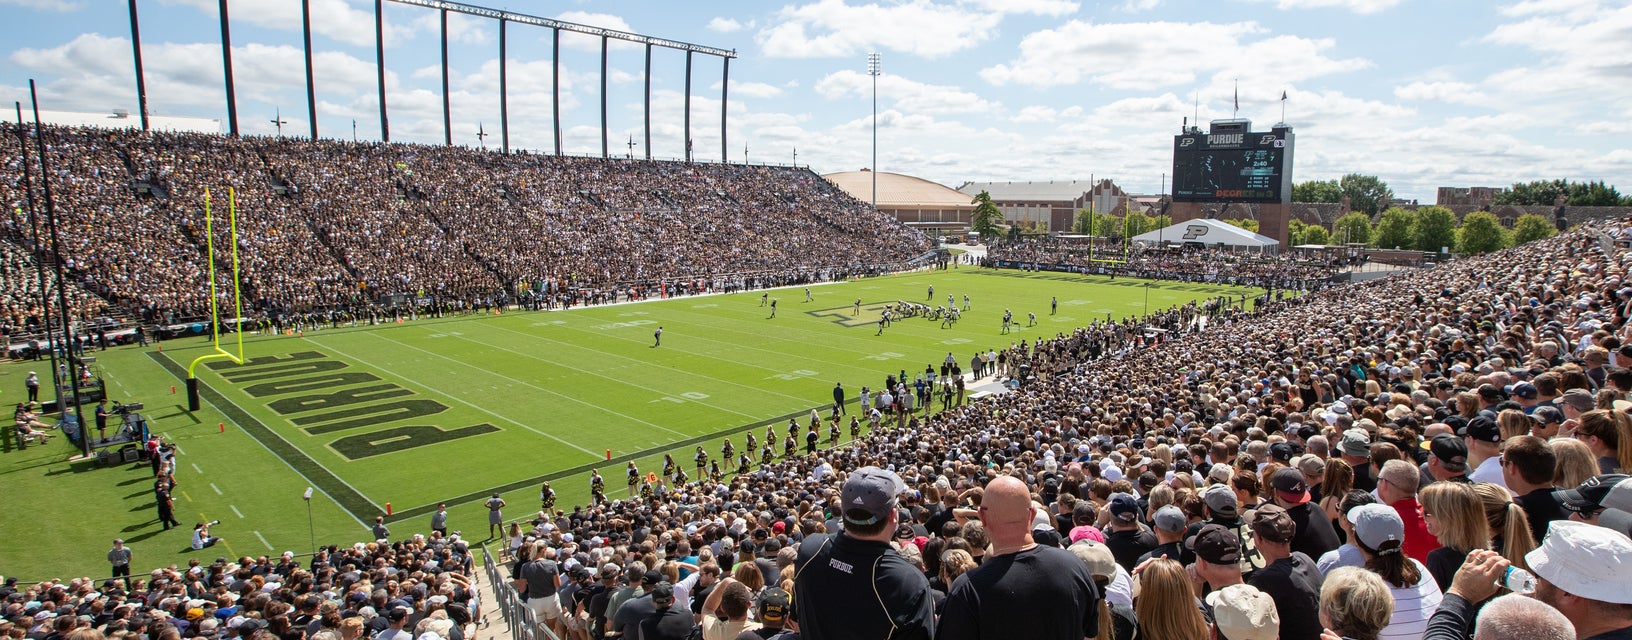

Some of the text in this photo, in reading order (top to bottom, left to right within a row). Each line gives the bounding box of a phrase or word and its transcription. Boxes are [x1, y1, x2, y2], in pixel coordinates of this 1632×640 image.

[1180, 138, 1194, 146] P
[1207, 134, 1243, 144] PURDUE
[1260, 135, 1276, 144] P
[1182, 225, 1208, 239] P
[660, 391, 711, 404] 10
[201, 350, 506, 462] PURDUE
[828, 557, 854, 574] PURDUE
